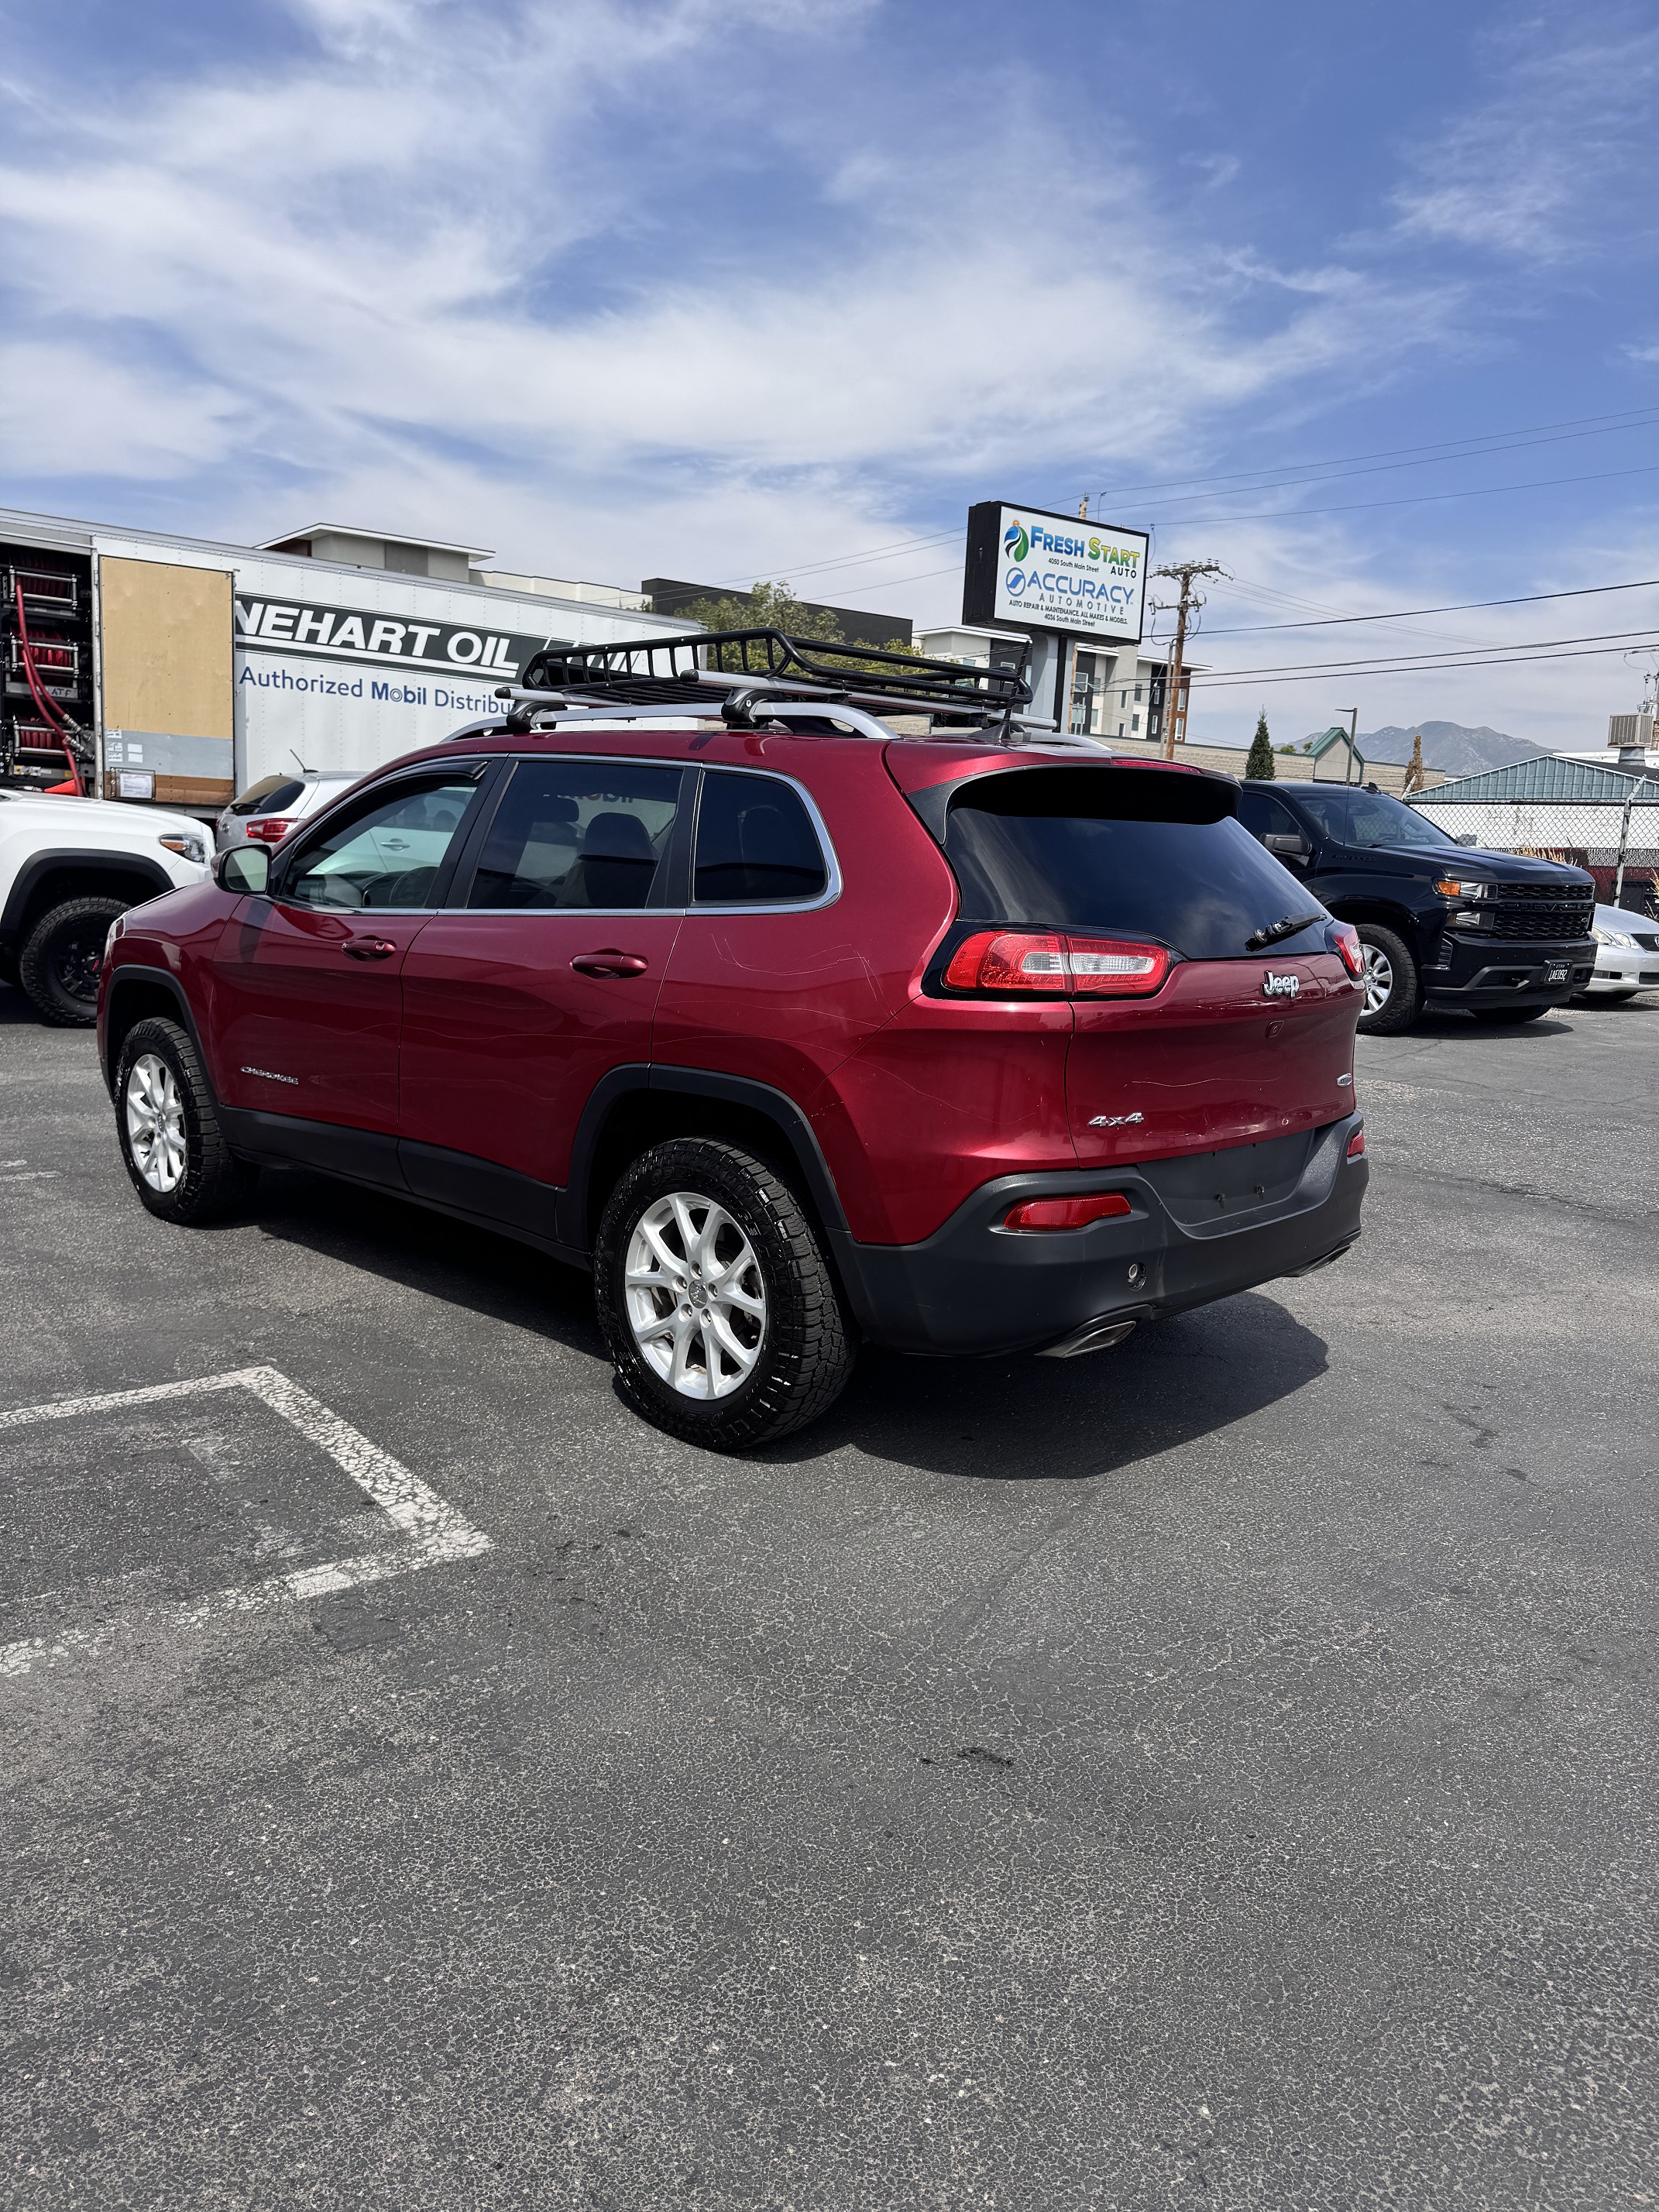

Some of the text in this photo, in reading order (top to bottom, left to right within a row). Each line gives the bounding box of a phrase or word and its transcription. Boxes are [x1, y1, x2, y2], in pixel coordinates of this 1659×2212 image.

[1030, 526, 1140, 568] FRESH START
[1060, 559, 1073, 568] South
[1111, 566, 1137, 579] AUTO
[1027, 570, 1134, 605] ACCURACY
[1023, 602, 1039, 610] REPAIR
[1089, 613, 1104, 621] MAKES
[1039, 592, 1124, 615] AUTOMOTIVE
[446, 630, 520, 670] OIL
[239, 666, 363, 698] Authorized
[370, 682, 427, 706] Mobil
[1262, 970, 1300, 998] Jeep
[1088, 1112, 1144, 1127] 4x4
